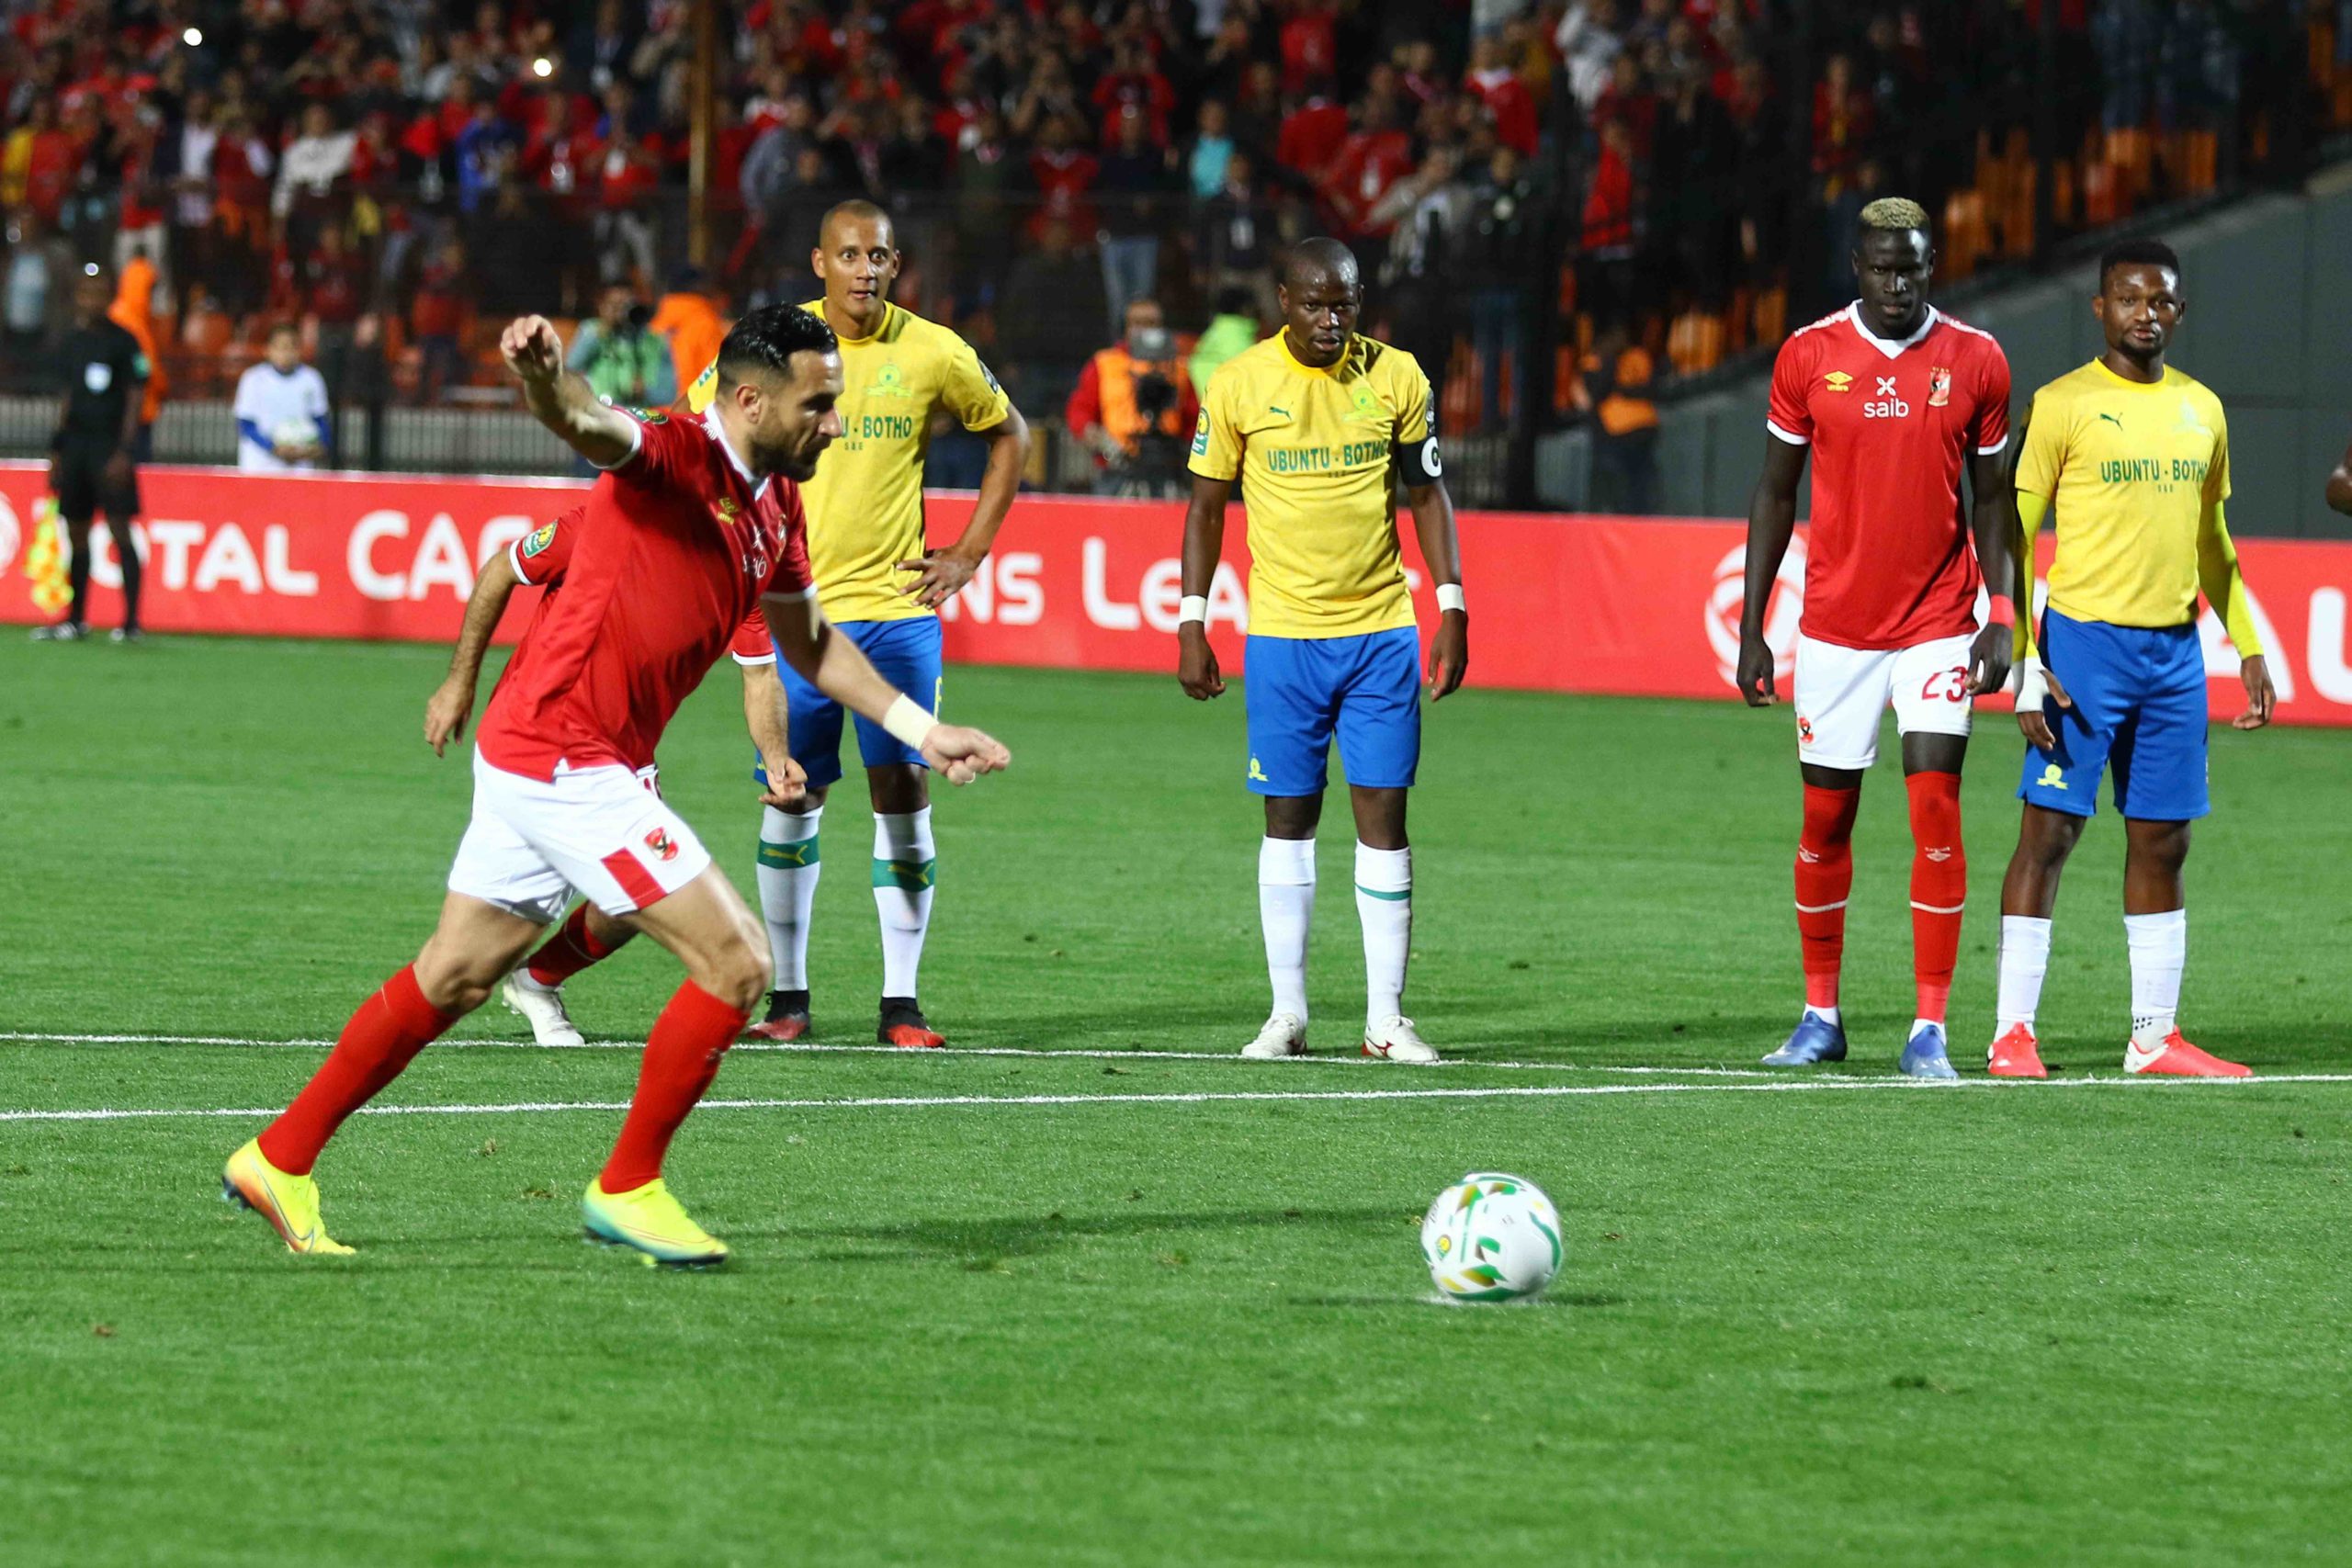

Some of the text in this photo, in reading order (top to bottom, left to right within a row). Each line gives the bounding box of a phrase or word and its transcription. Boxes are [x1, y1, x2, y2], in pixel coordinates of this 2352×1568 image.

[1863, 398, 1910, 419] saib
[863, 415, 912, 439] BOTHO
[1267, 446, 1330, 471] UBUNTU
[2100, 458, 2209, 483] UBUNTU BOTH
[1921, 665, 1968, 703] 23
